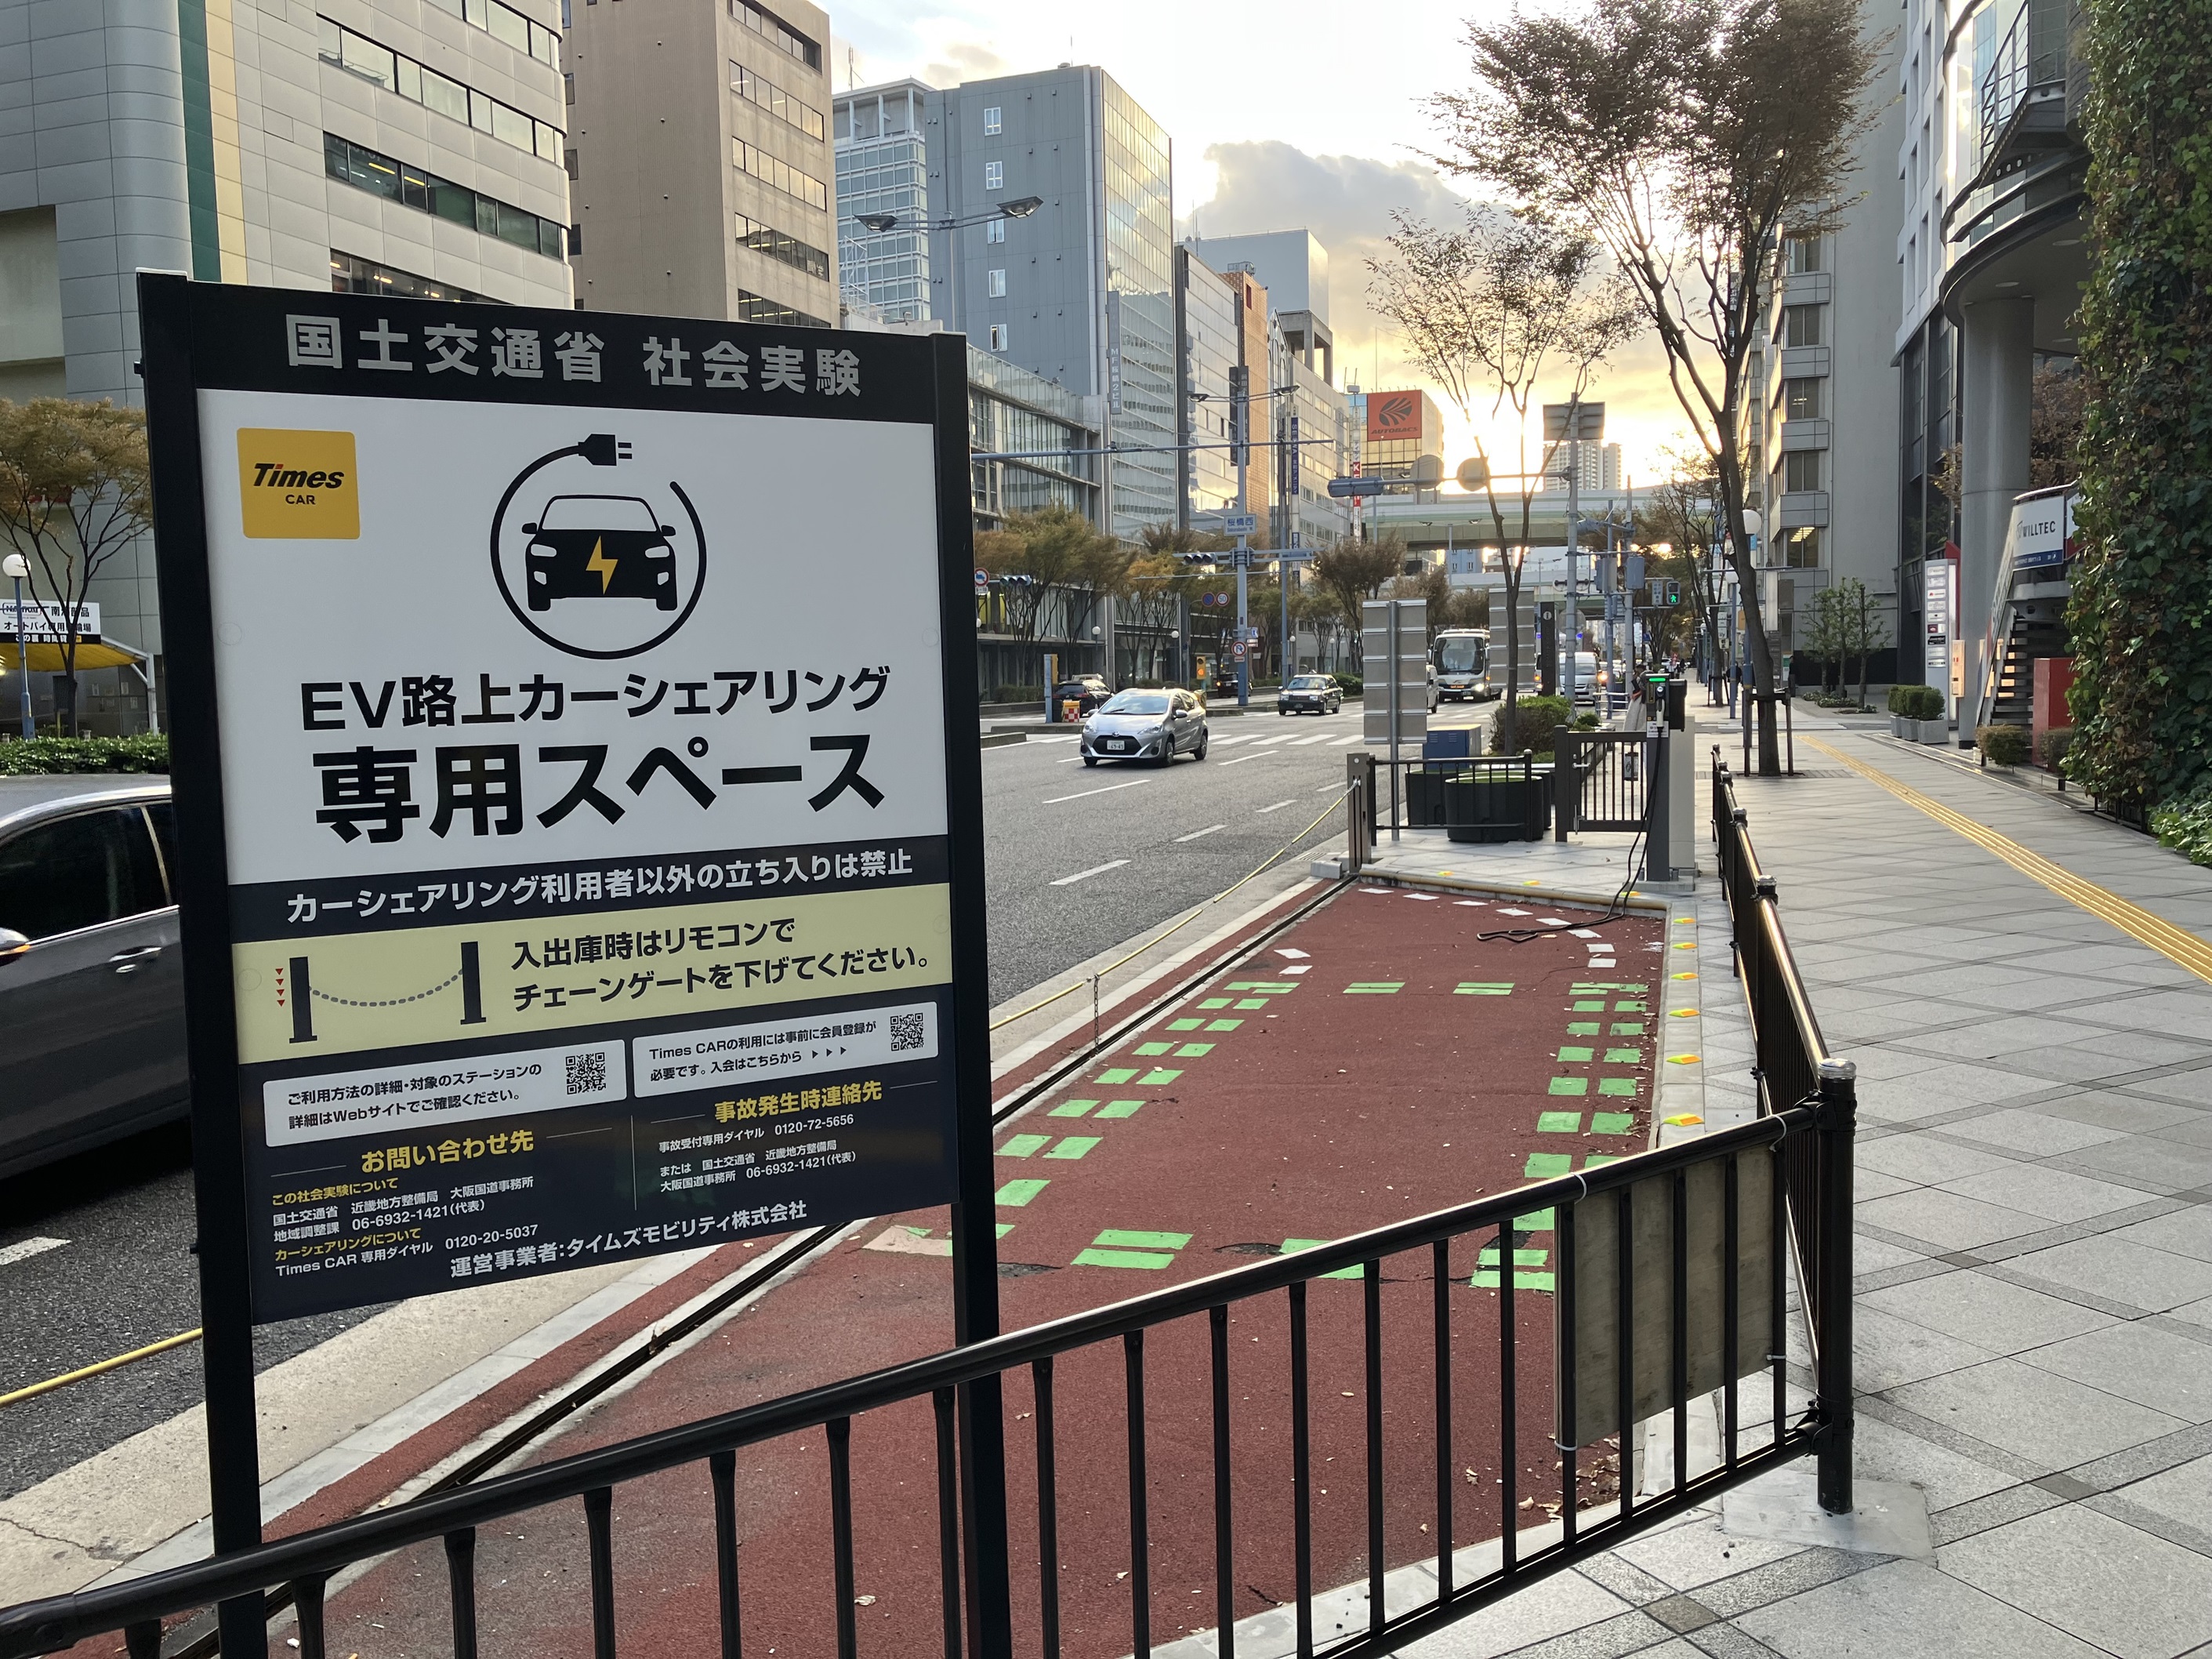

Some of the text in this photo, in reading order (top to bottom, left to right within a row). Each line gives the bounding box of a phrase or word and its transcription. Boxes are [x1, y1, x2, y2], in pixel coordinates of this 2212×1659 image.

[286, 314, 861, 396] 国土交通省 社会実験
[254, 463, 344, 488] Times
[285, 495, 315, 504] CAR
[1227, 517, 1253, 526] 桜橋西
[2023, 521, 2056, 538] WILLTEC
[301, 666, 890, 730] EV路上カーシェアリング
[313, 735, 884, 843] 専用スペース
[288, 848, 912, 923] カーシェアリング利用者以外の立ち入りは禁止
[512, 918, 795, 970] 入出庫時はリモコンで
[514, 947, 927, 1011] チェーンゲートを下げてください。
[648, 1021, 877, 1060] Times CARの利用には事前に会員登録が
[289, 1090, 519, 1129] 詳細はWebサイトでご確認ください。
[715, 1080, 882, 1123] 事故発生時連絡先
[362, 1130, 533, 1172] お問い合わせ先
[659, 1114, 854, 1153] 事故受付専用ダイヤル 0120-72-5656
[660, 1140, 836, 1177] または 国土交通省 近畿地方整備局
[273, 1178, 398, 1205] この社会実験について
[274, 1176, 533, 1226] 国土交通省 近畿地方整備局 大阪国道事務所
[661, 1171, 735, 1192] 大阪国道事務所
[274, 1222, 339, 1242] 地域調整課
[275, 1228, 421, 1261] カーシェアリングについて
[276, 1225, 538, 1276] Times CAR 専用ダイヤル 0120-20-5037
[451, 1200, 807, 1277] 運営事業者:タイムズモビリティ株式会社
